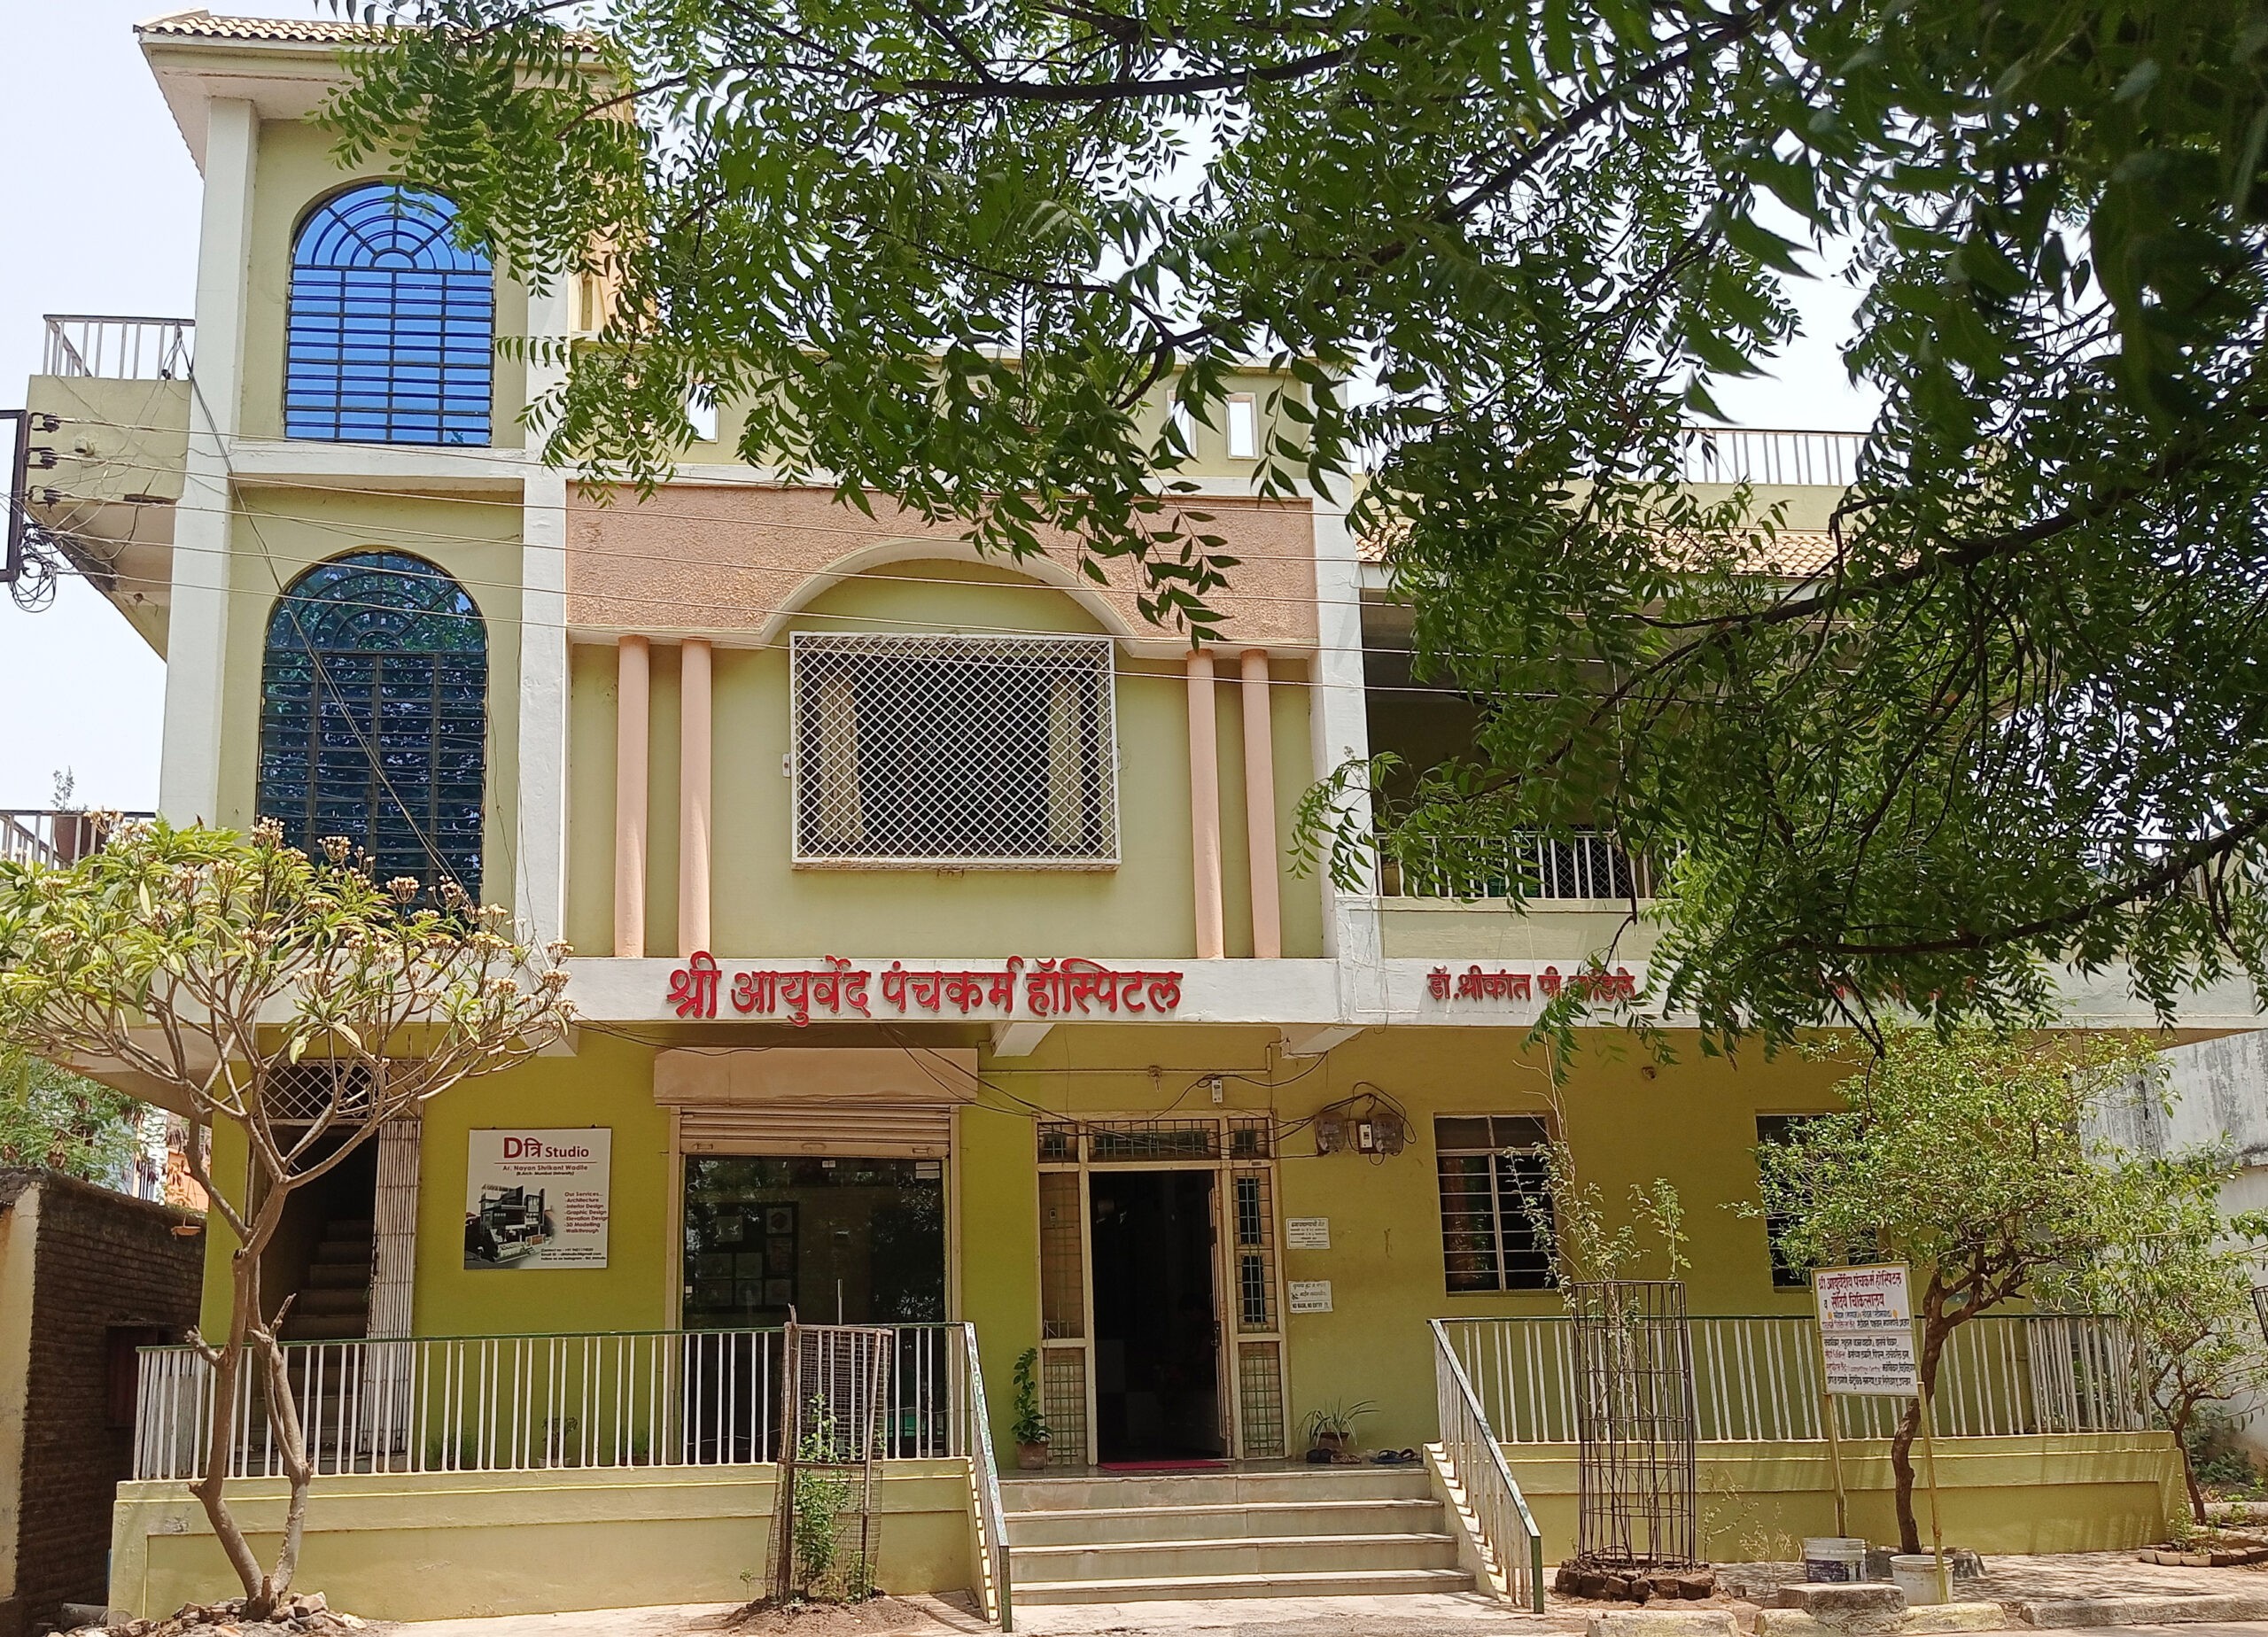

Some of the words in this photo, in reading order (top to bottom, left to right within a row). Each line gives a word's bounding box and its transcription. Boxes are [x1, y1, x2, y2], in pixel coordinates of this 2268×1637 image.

[666, 951, 722, 1020] श्री
[881, 956, 1025, 1013] पंचकर्म
[1028, 957, 1184, 1017] हॉस्पिटल
[545, 1145, 589, 1158] Studio
